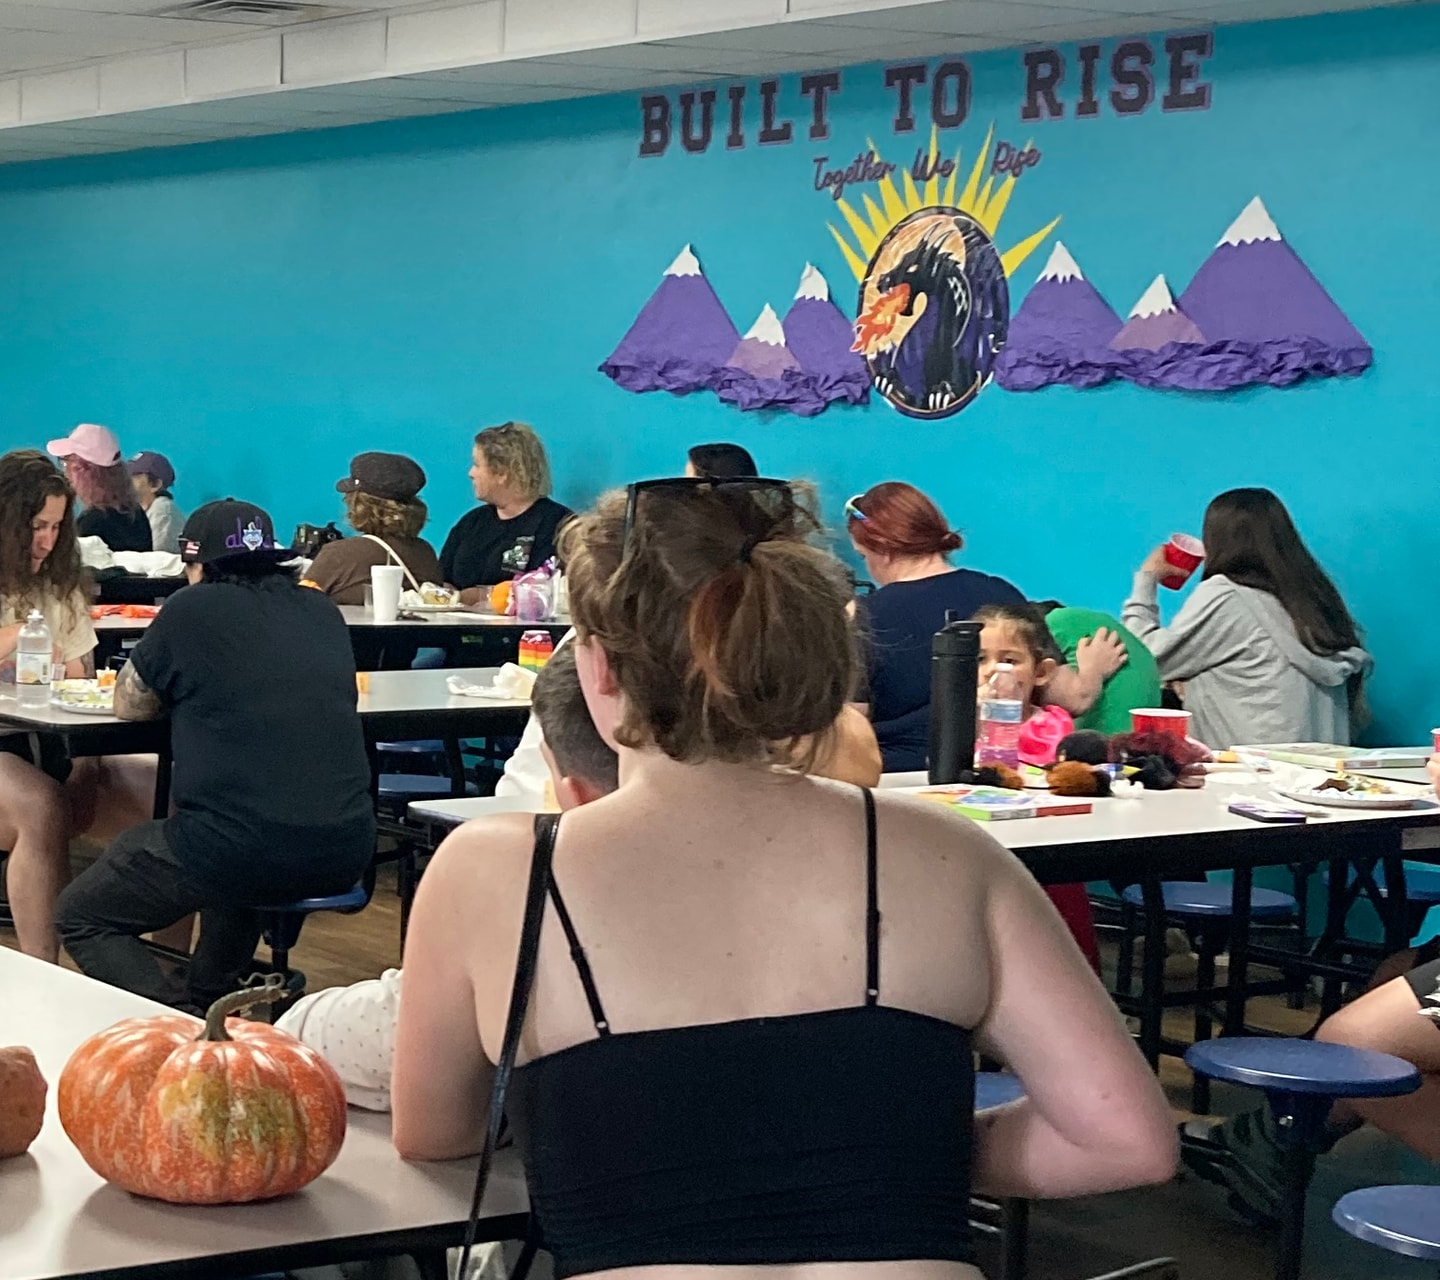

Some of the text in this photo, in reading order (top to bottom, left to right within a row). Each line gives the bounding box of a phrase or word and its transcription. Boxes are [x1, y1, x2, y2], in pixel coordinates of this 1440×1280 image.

[639, 31, 1214, 158] BUILT TO RISE
[813, 139, 1042, 201] Together We Rise
